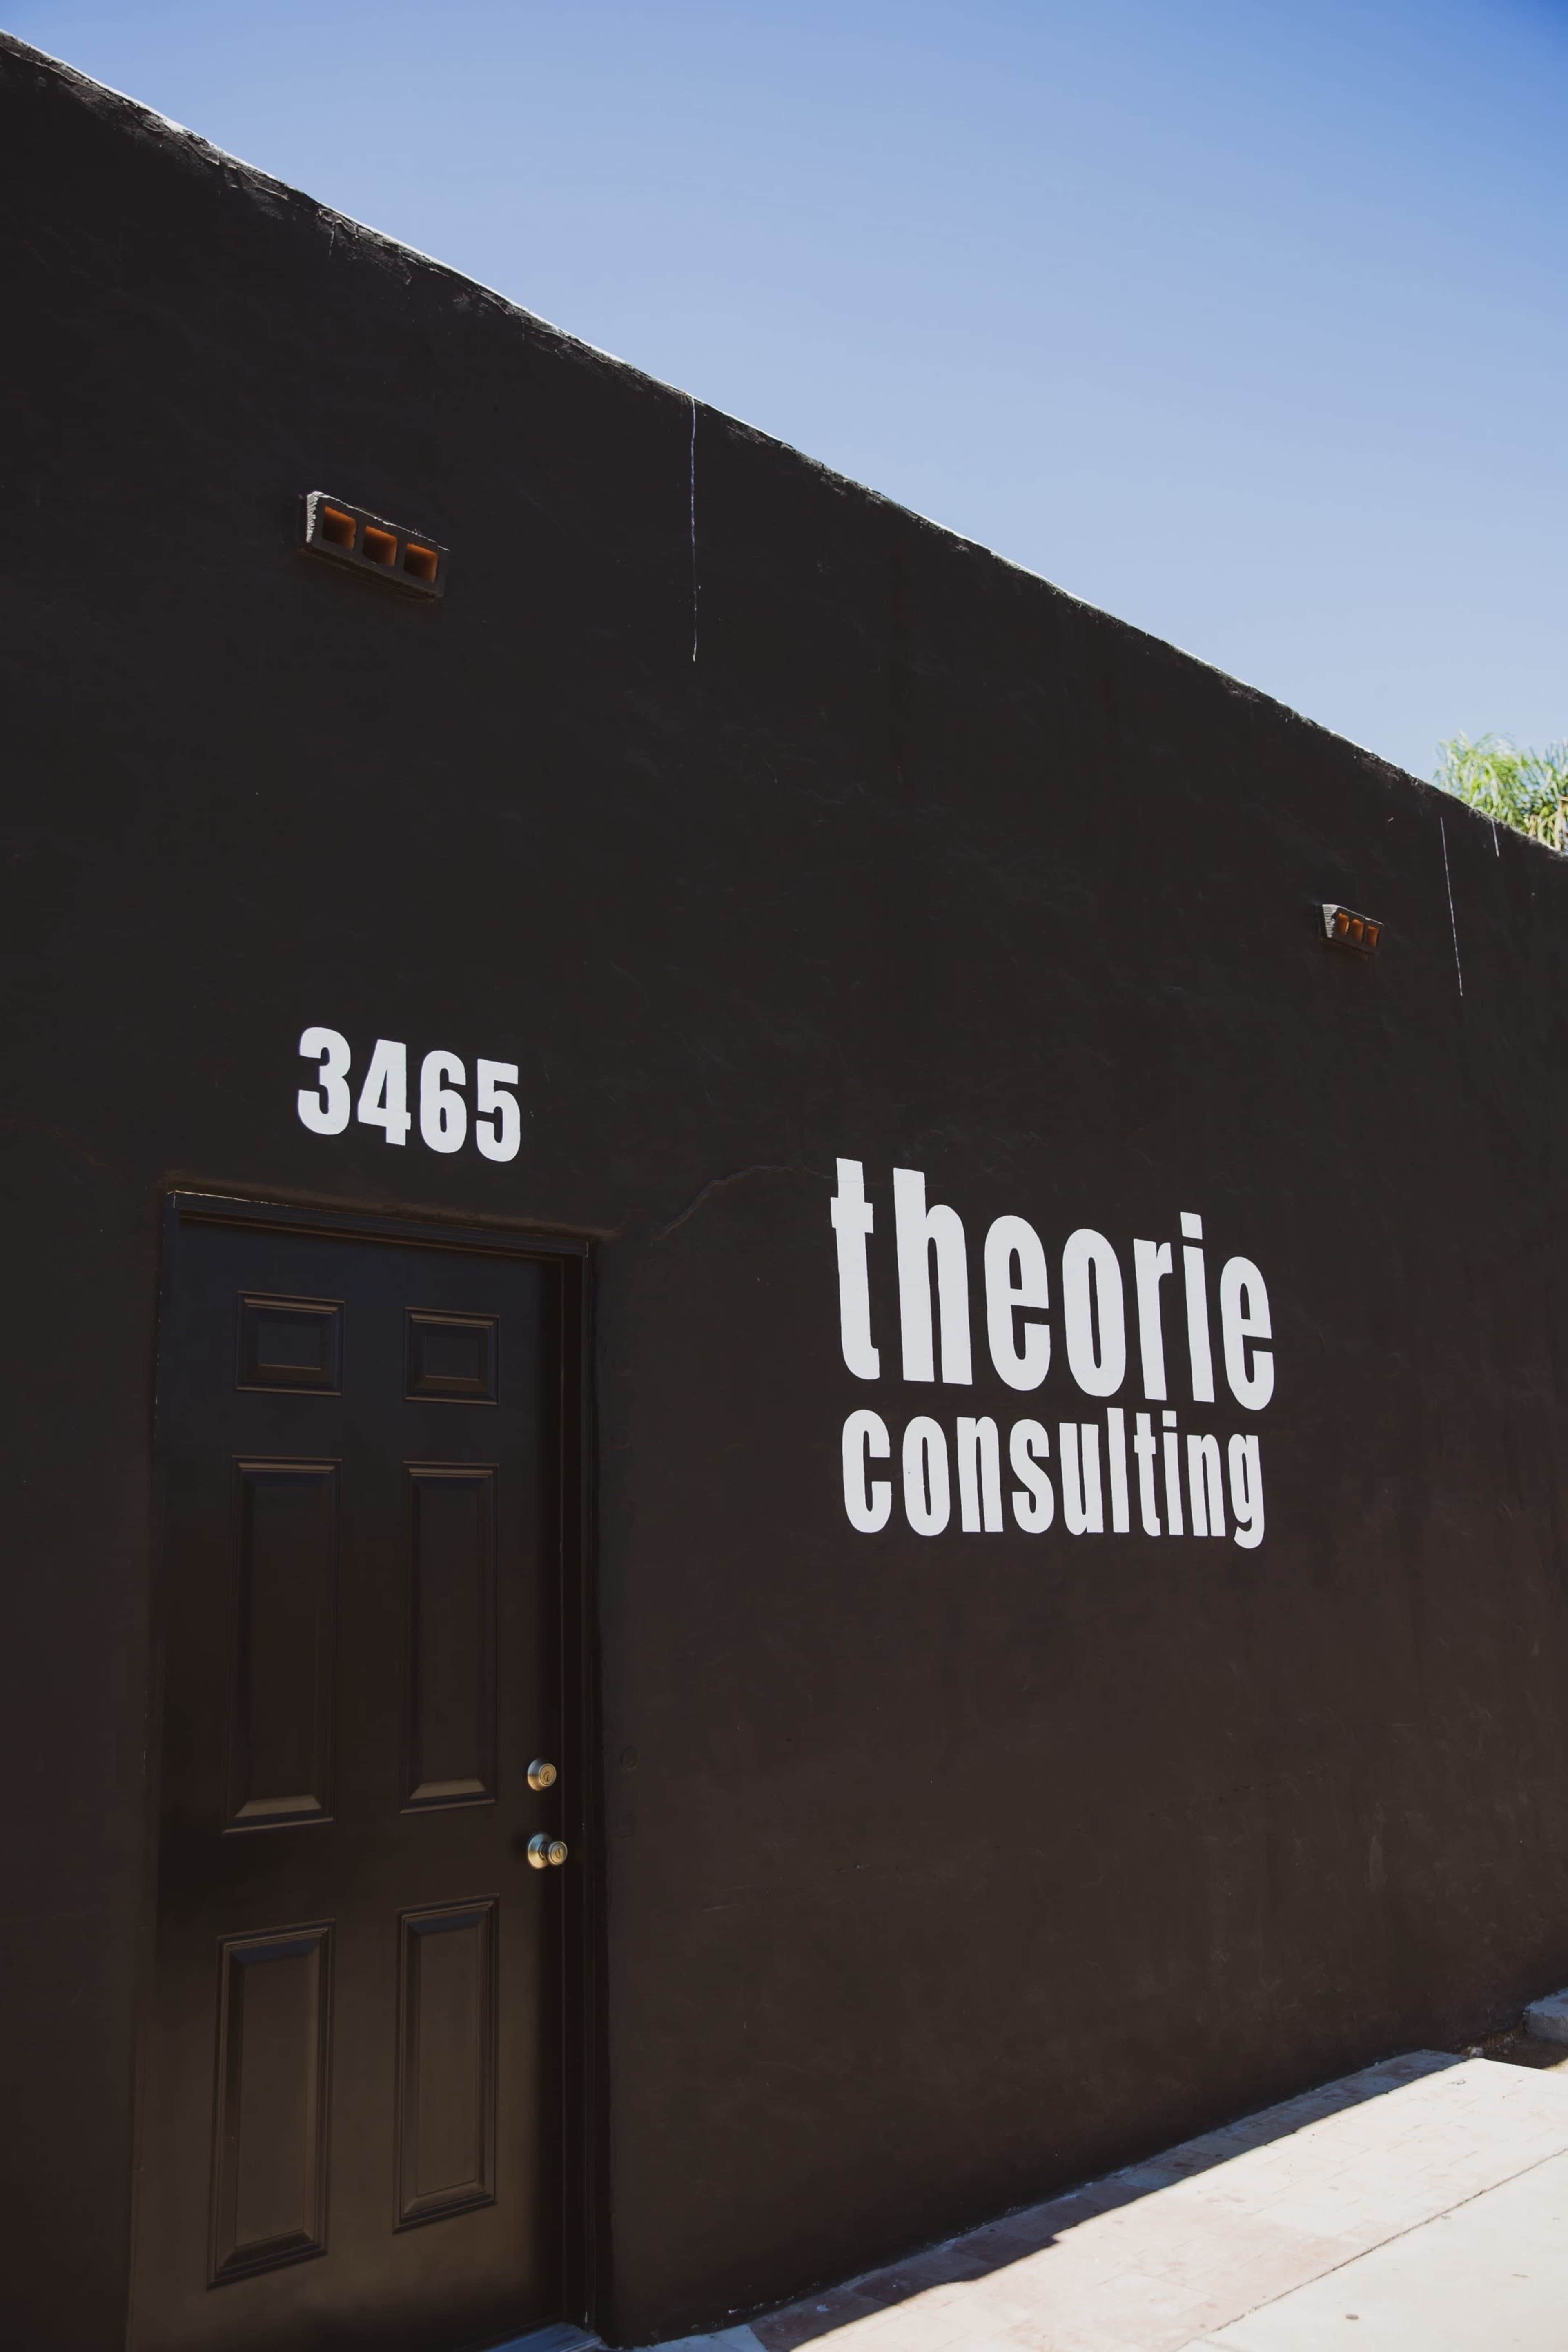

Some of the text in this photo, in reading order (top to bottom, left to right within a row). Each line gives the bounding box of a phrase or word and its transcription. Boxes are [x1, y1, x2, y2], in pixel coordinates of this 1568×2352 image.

[298, 1027, 520, 1162] 3465
[831, 1158, 1274, 1410] theorie
[842, 1408, 1264, 1548] consulting
